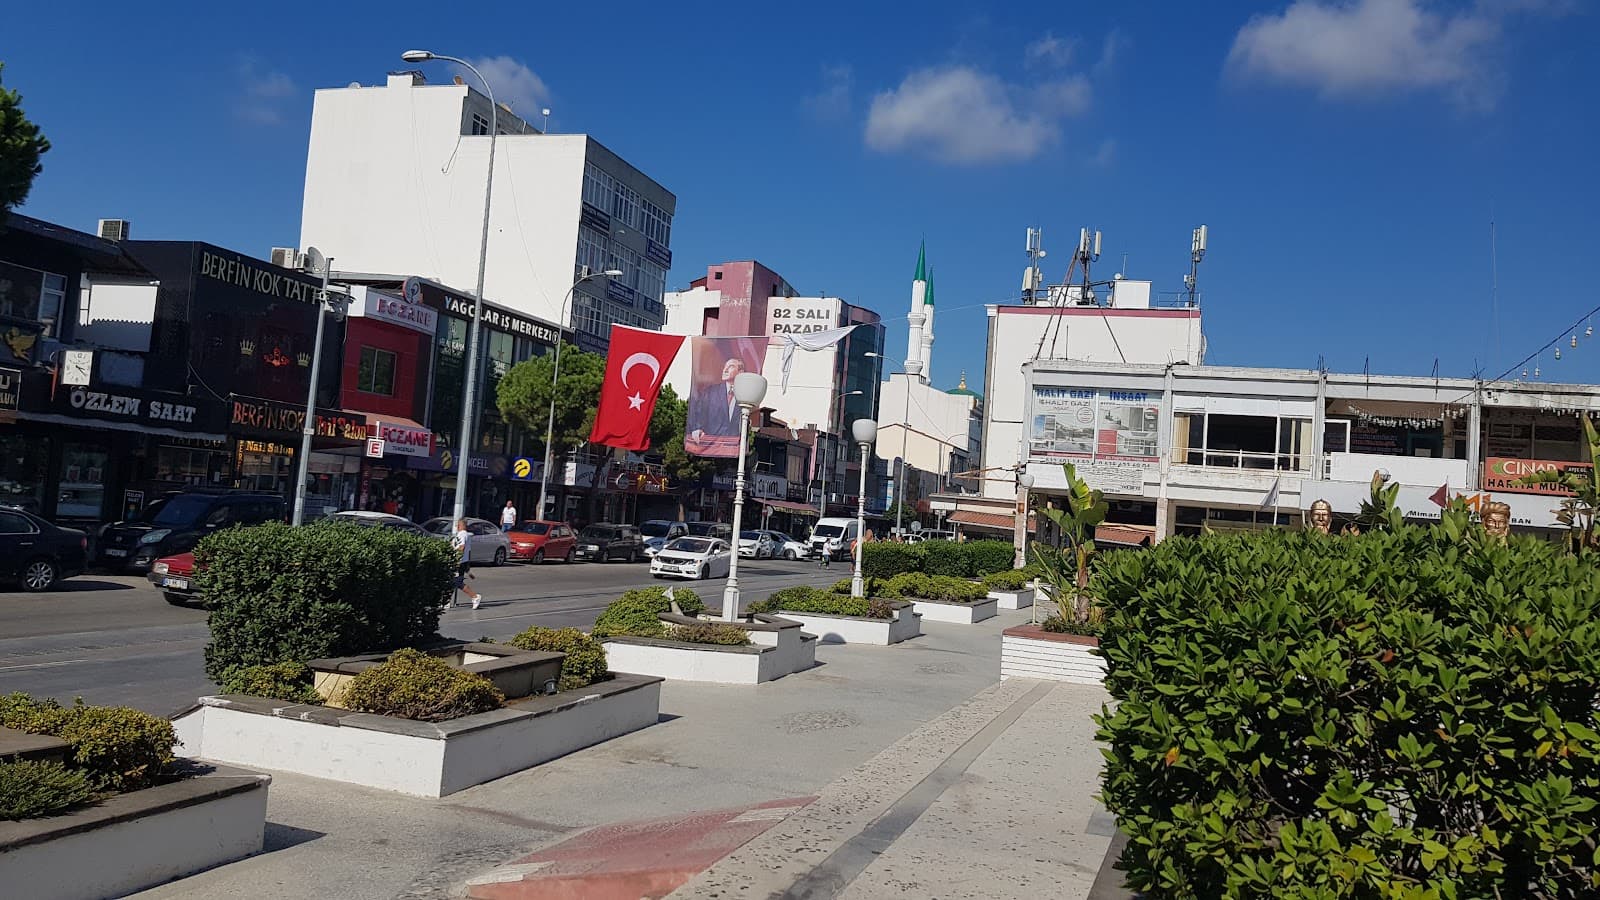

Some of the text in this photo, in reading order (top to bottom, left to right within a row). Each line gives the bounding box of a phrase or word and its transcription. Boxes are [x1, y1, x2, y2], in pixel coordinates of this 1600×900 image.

[201, 251, 321, 305] BERFİN KOK TATT
[444, 295, 500, 325] YAĞCLAR
[773, 308, 830, 320] 82 SALI
[149, 400, 197, 423] SAAT
[381, 426, 429, 448] ECZANE
[245, 440, 266, 453] Nail
[371, 443, 380, 454] E
[454, 455, 488, 469] TKCELL
